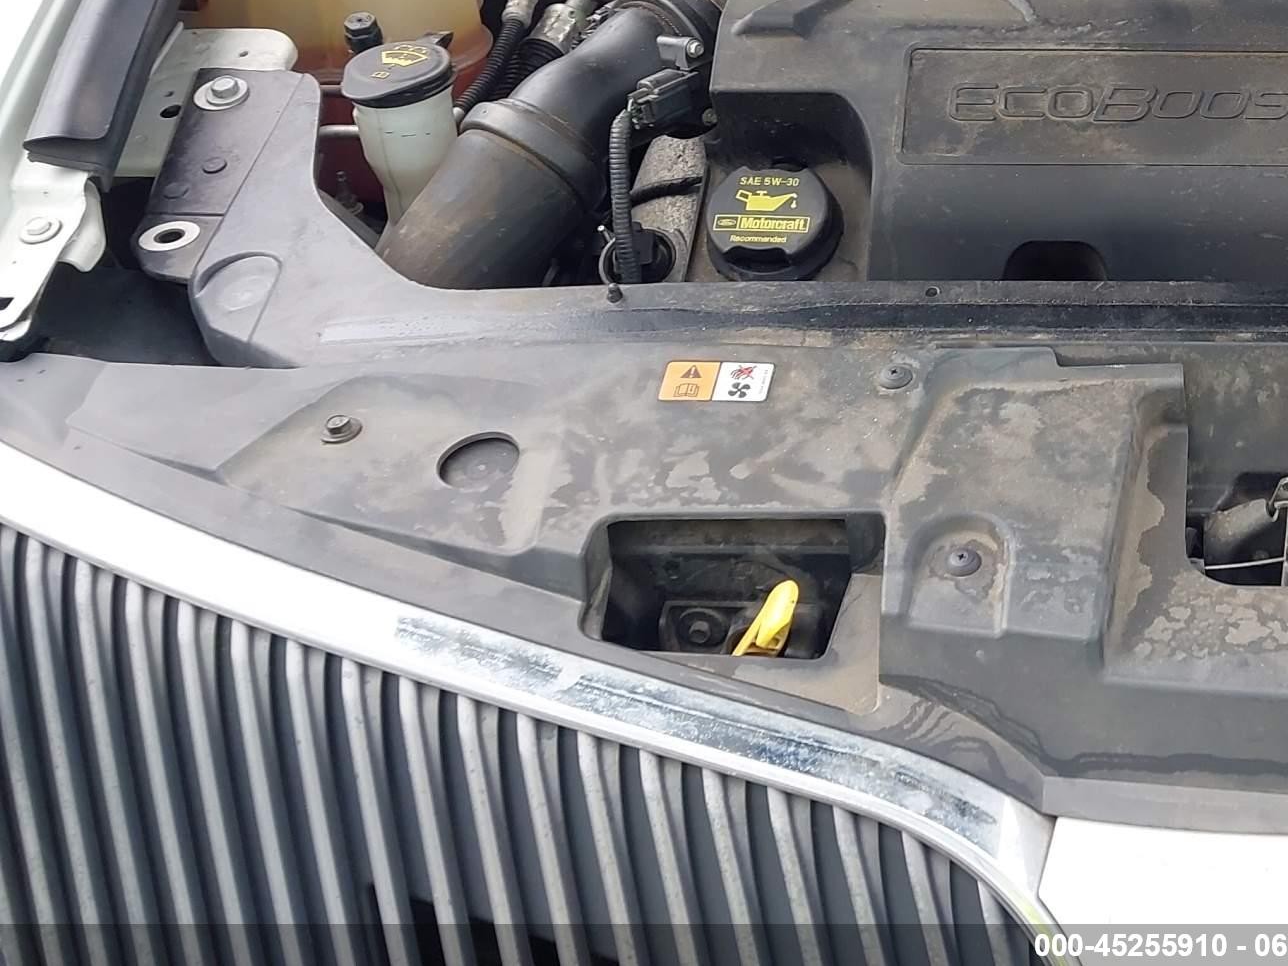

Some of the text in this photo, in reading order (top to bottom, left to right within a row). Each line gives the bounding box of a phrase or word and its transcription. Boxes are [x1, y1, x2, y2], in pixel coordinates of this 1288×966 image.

[740, 177, 800, 186] SAE 5W-30
[741, 217, 805, 229] Motorcraft
[730, 235, 786, 243] Recommended
